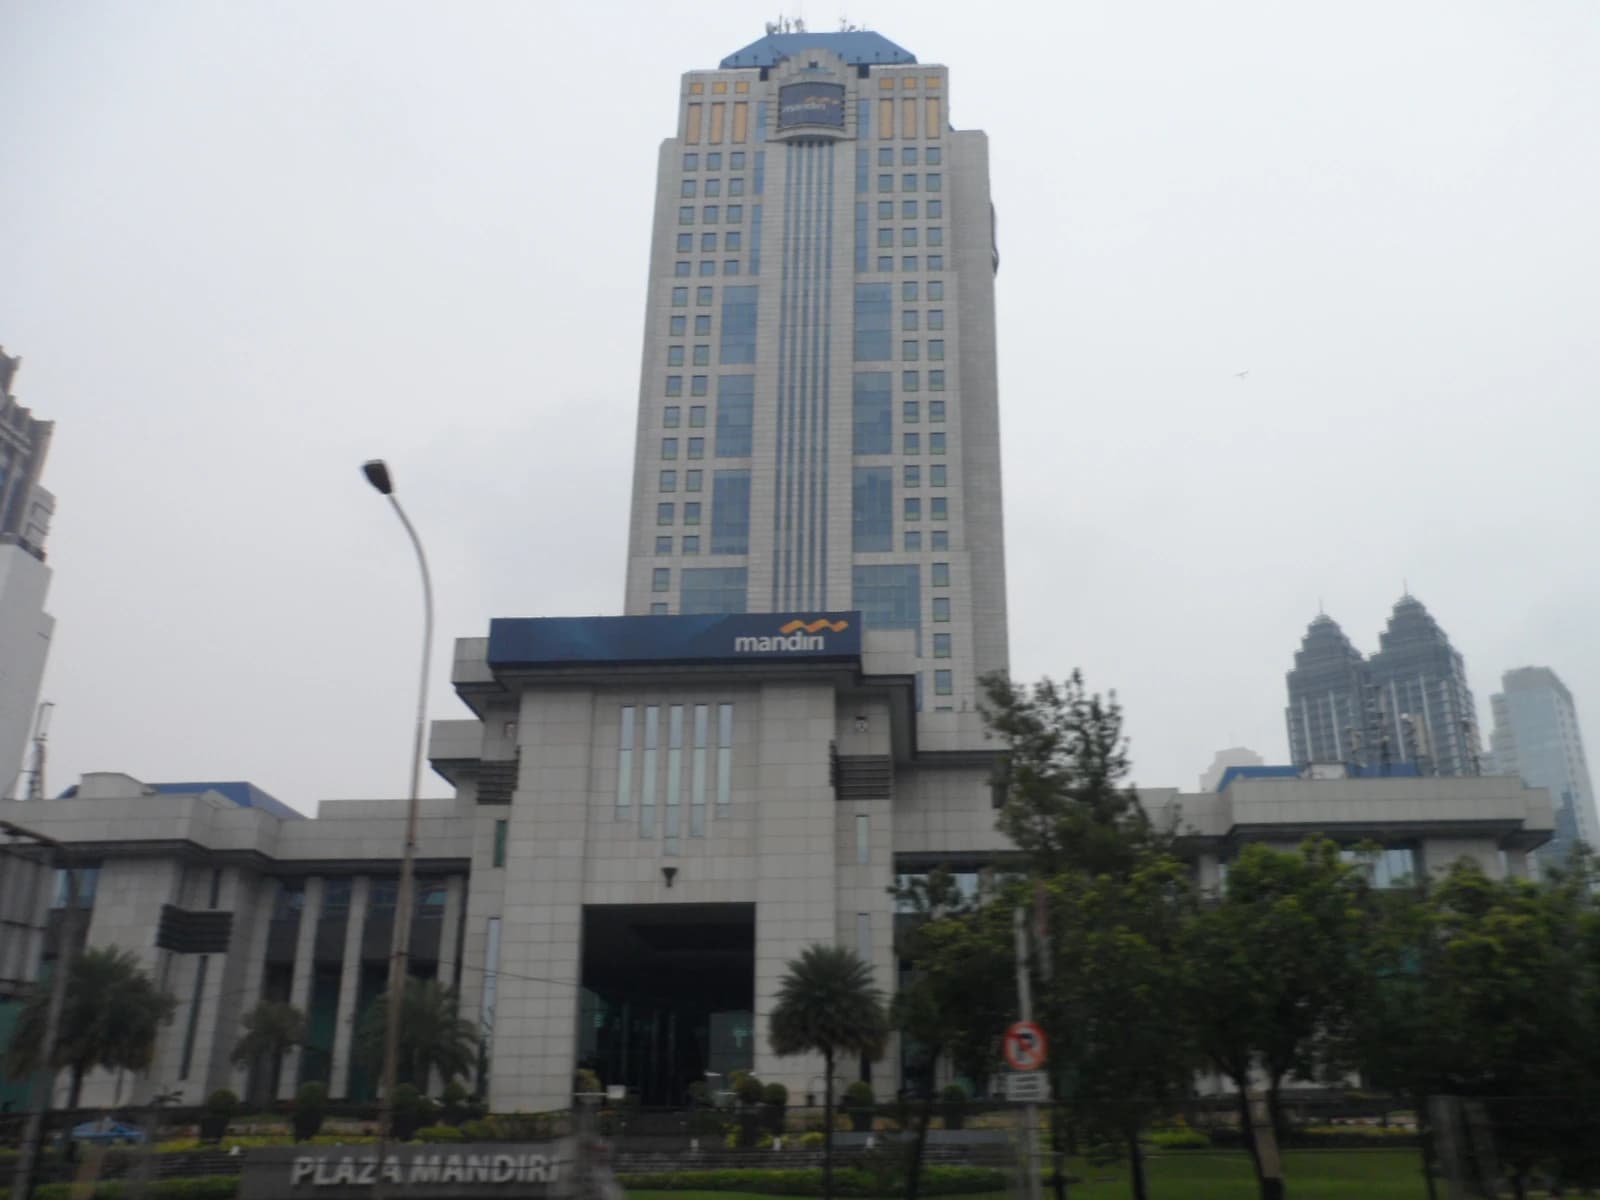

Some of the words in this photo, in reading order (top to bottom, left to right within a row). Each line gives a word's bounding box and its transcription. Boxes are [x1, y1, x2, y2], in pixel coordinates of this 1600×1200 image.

[735, 631, 824, 652] mandiri
[289, 1156, 401, 1185] PLAZA
[408, 1155, 560, 1183] MANDIRI
